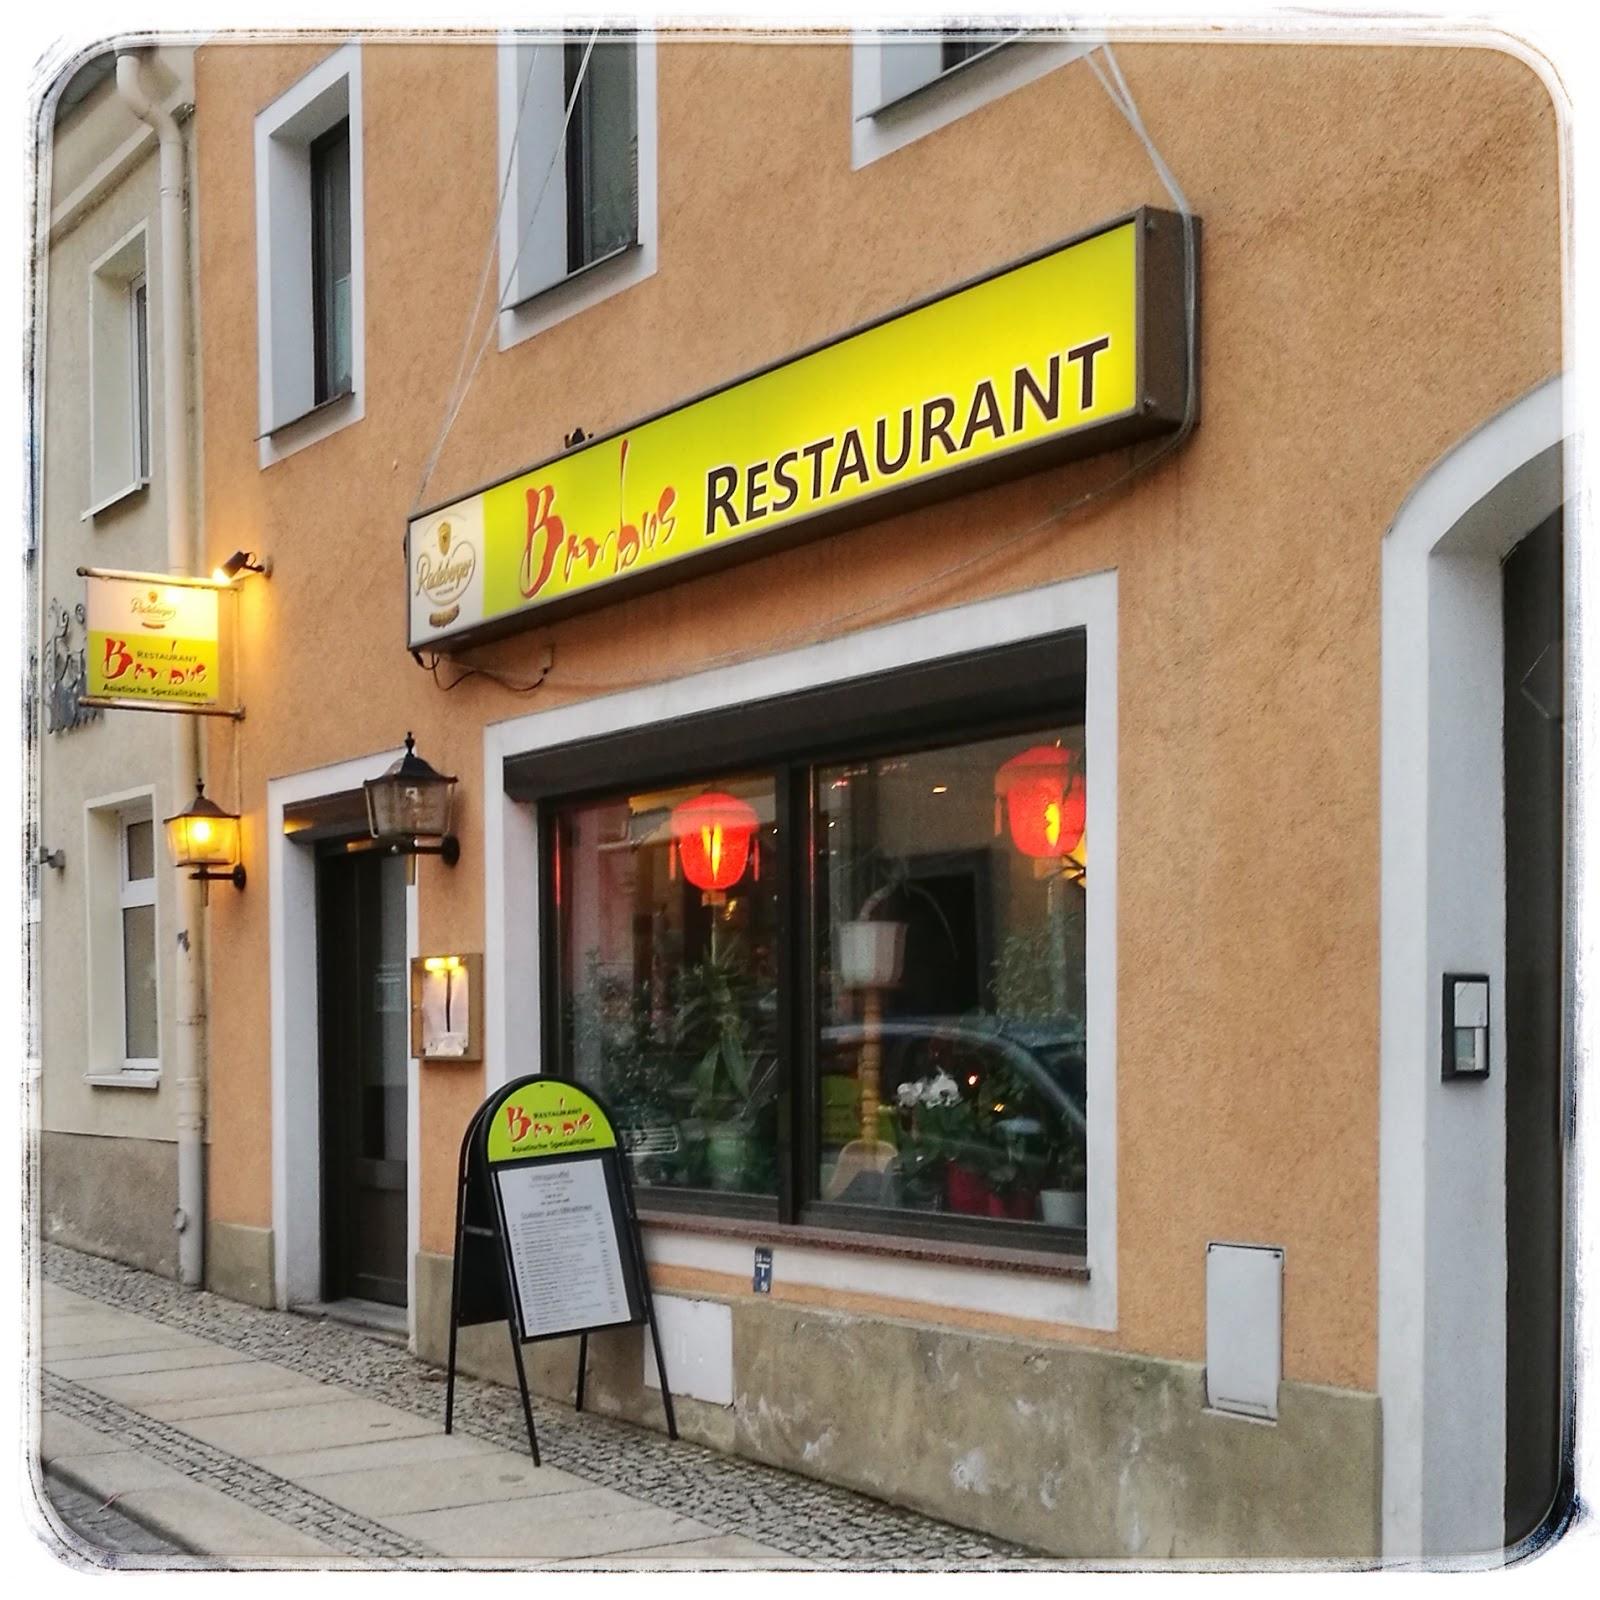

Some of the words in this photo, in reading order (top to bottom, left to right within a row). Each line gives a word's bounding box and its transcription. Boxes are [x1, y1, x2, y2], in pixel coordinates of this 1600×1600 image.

[519, 439, 677, 599] Bambus
[705, 336, 1110, 537] RESTAURANT
[102, 683, 149, 695] Asiatische
[150, 686, 208, 699] Spezialitäten
